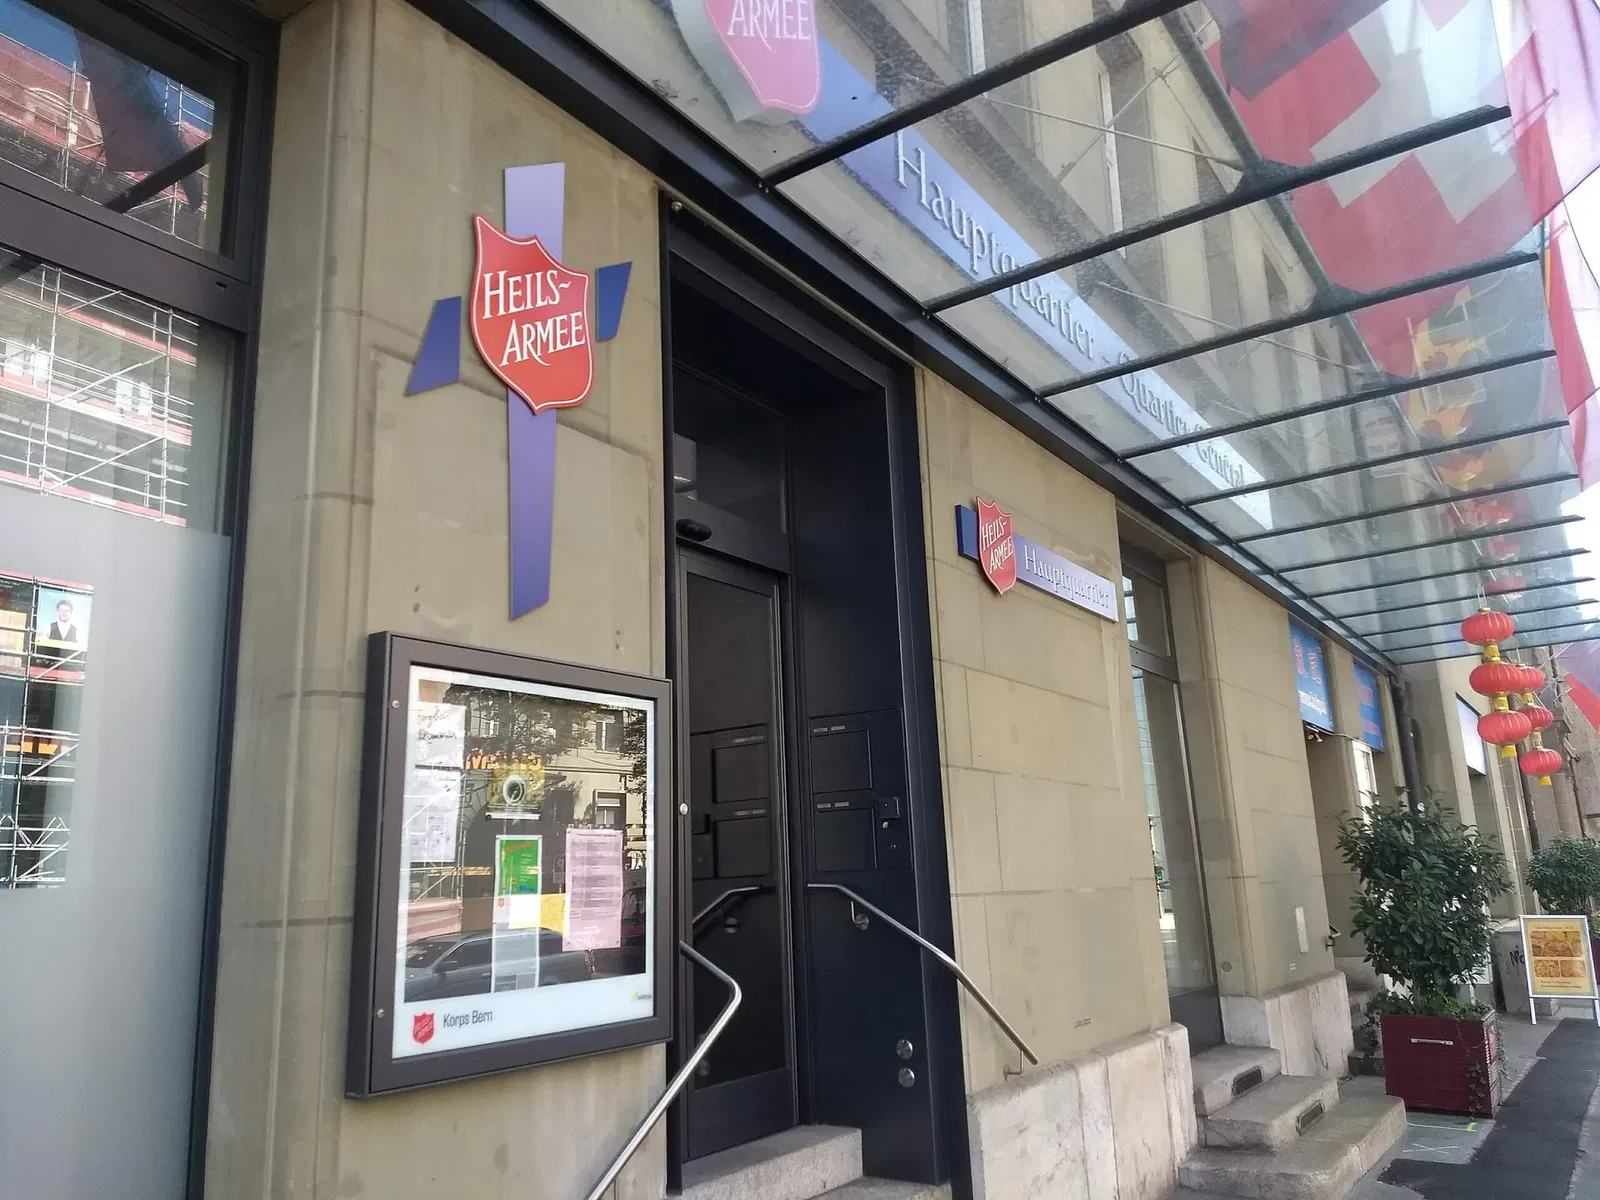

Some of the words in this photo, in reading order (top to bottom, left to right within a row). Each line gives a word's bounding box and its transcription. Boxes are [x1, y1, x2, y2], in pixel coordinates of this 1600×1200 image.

[726, 0, 812, 54] ARMEE
[895, 128, 1095, 361] Hauptquartier
[500, 311, 586, 367] ARMEE
[988, 535, 1014, 575] ARMEE
[1023, 545, 1110, 609] Hauptquartier
[442, 1012, 470, 1029] Korps
[471, 1009, 494, 1024] Bern
